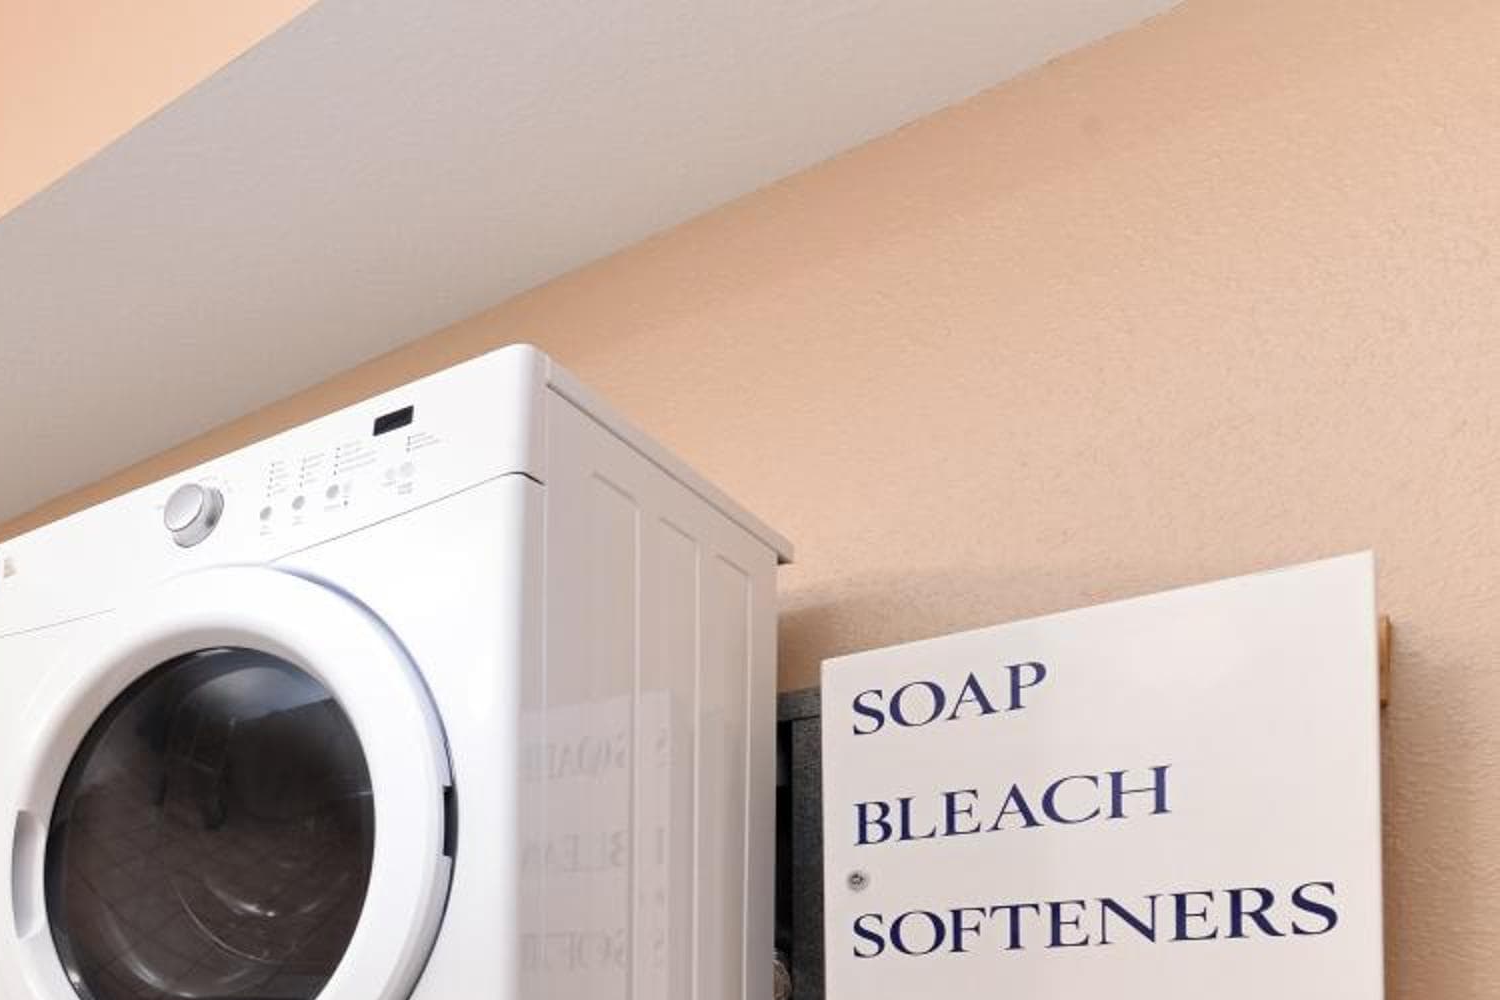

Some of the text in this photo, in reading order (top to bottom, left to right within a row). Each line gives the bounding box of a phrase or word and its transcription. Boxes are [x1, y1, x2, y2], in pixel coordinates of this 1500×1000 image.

[852, 661, 1047, 736] SOAP
[853, 765, 1172, 846] BLEACH
[852, 881, 1338, 959] SOFTENERS
